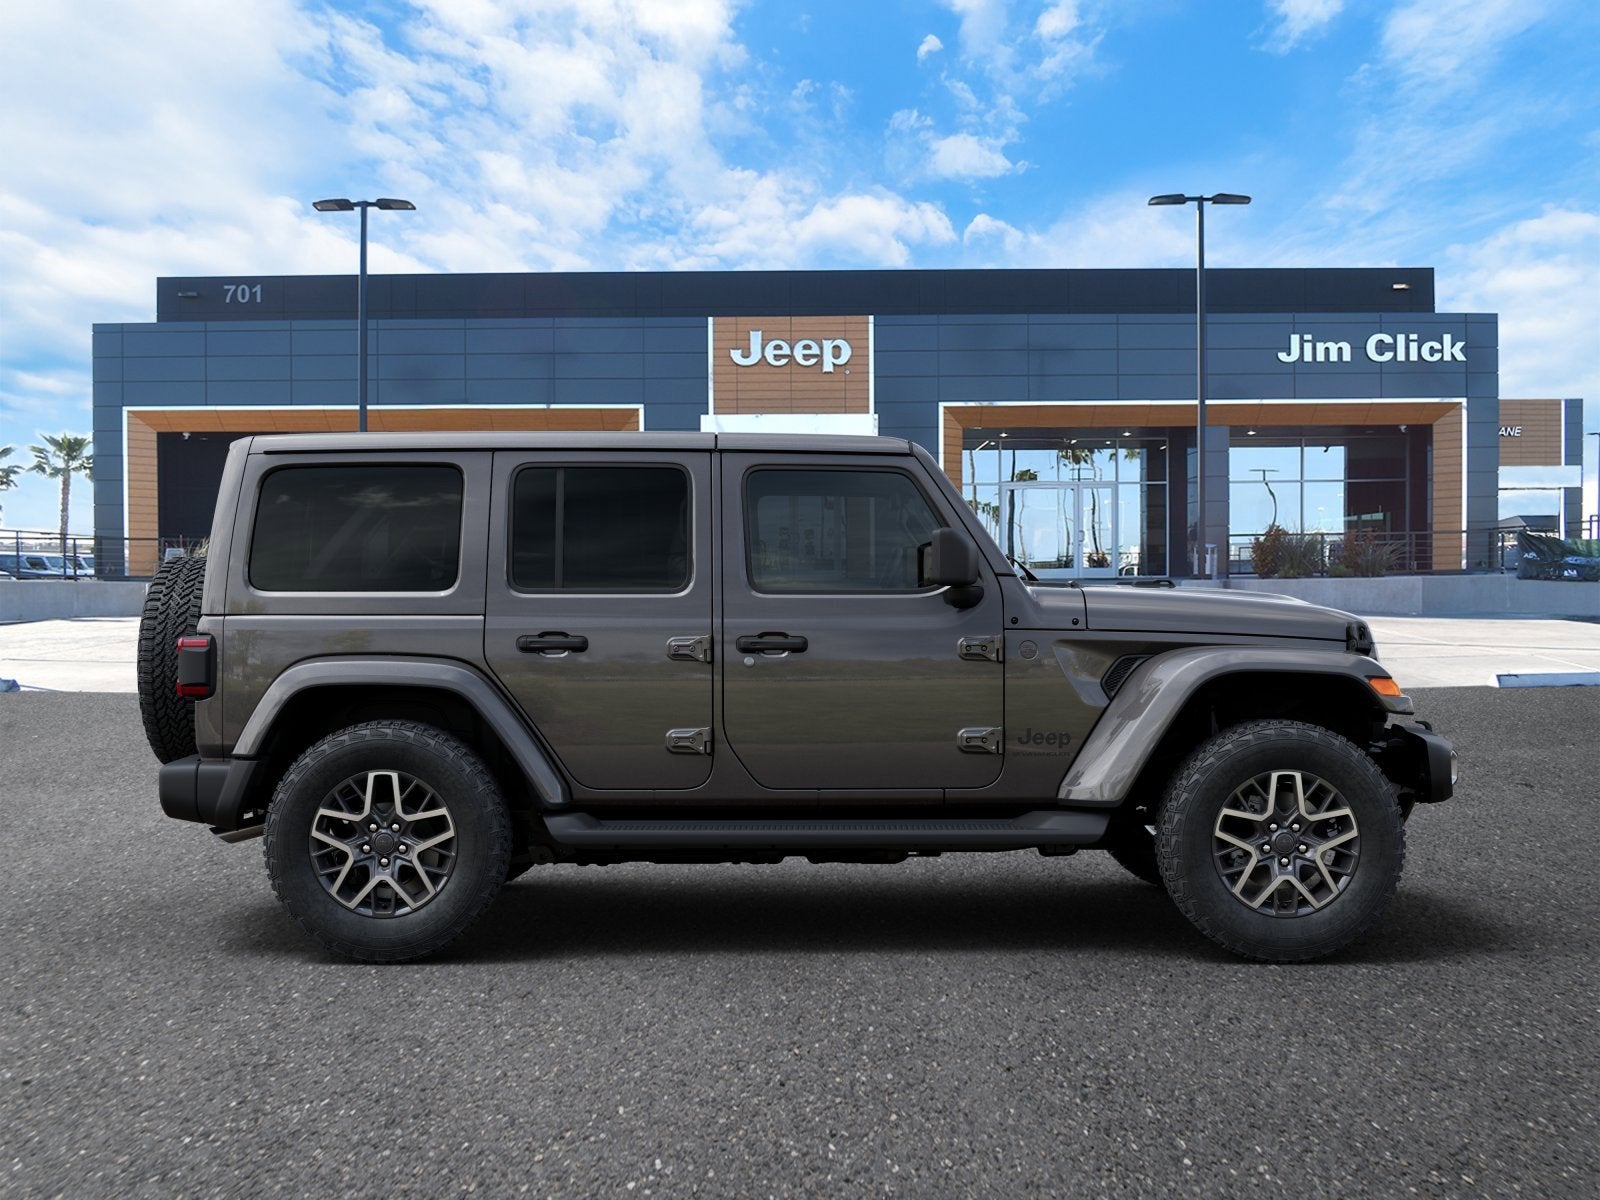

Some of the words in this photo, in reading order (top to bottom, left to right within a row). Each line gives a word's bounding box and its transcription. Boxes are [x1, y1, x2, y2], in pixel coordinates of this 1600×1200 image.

[223, 284, 262, 304] 701
[730, 330, 852, 373] Jeep
[1277, 333, 1352, 363] Jim
[1365, 333, 1467, 363] Click
[1018, 727, 1072, 749] Jeep
